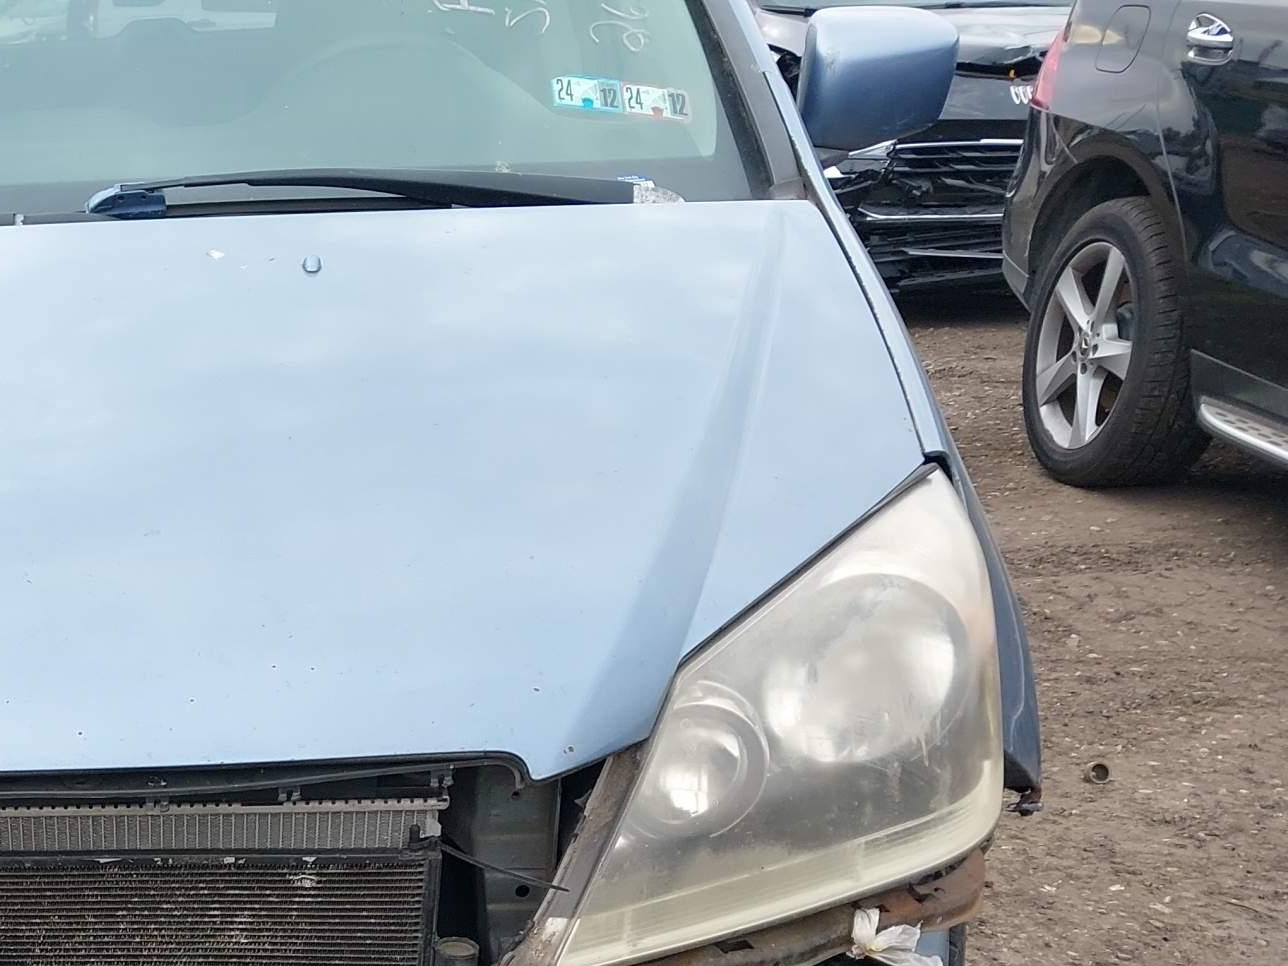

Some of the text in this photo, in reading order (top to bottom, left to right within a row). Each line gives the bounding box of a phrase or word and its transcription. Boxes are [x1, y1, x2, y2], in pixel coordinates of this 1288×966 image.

[556, 78, 619, 109] 24 12
[625, 86, 689, 117] 24 12
